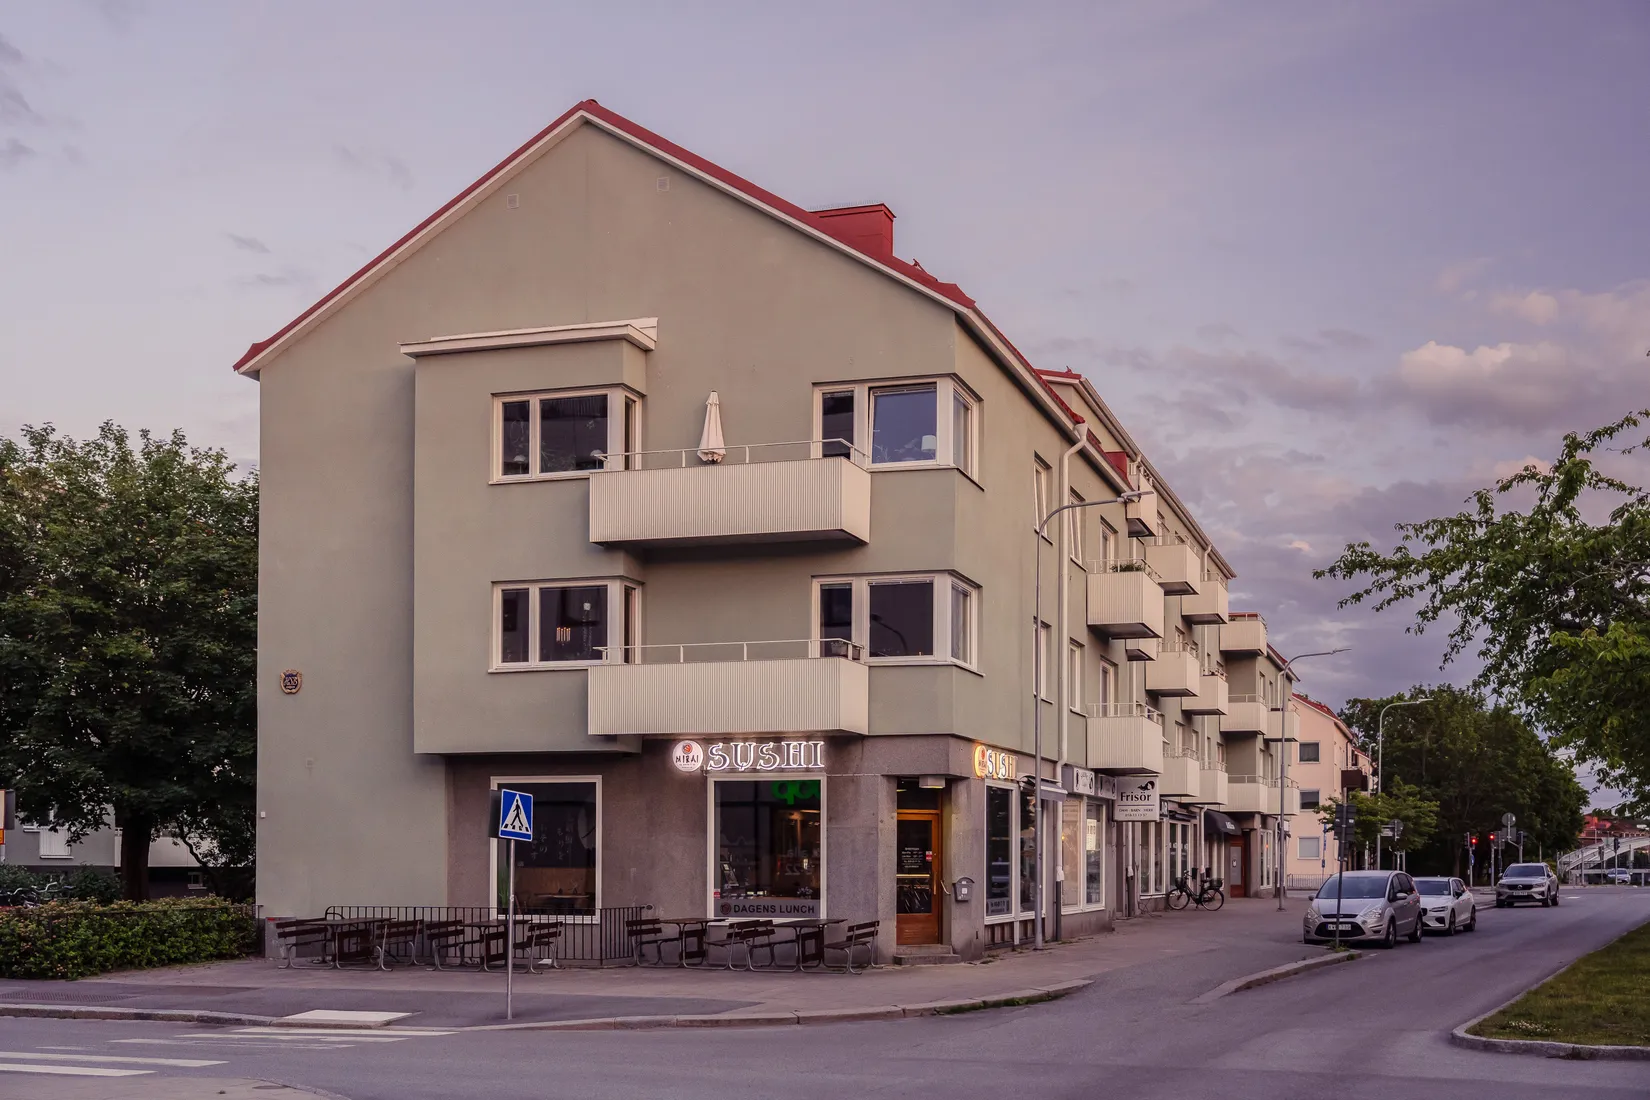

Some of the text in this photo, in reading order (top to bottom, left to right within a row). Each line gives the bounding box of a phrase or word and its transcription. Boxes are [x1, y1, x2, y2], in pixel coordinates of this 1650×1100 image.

[675, 754, 699, 763] MIRAI
[707, 741, 825, 771] SUSHI
[1120, 791, 1152, 801] Frisör
[733, 904, 815, 914] DAGENS LUNCH
